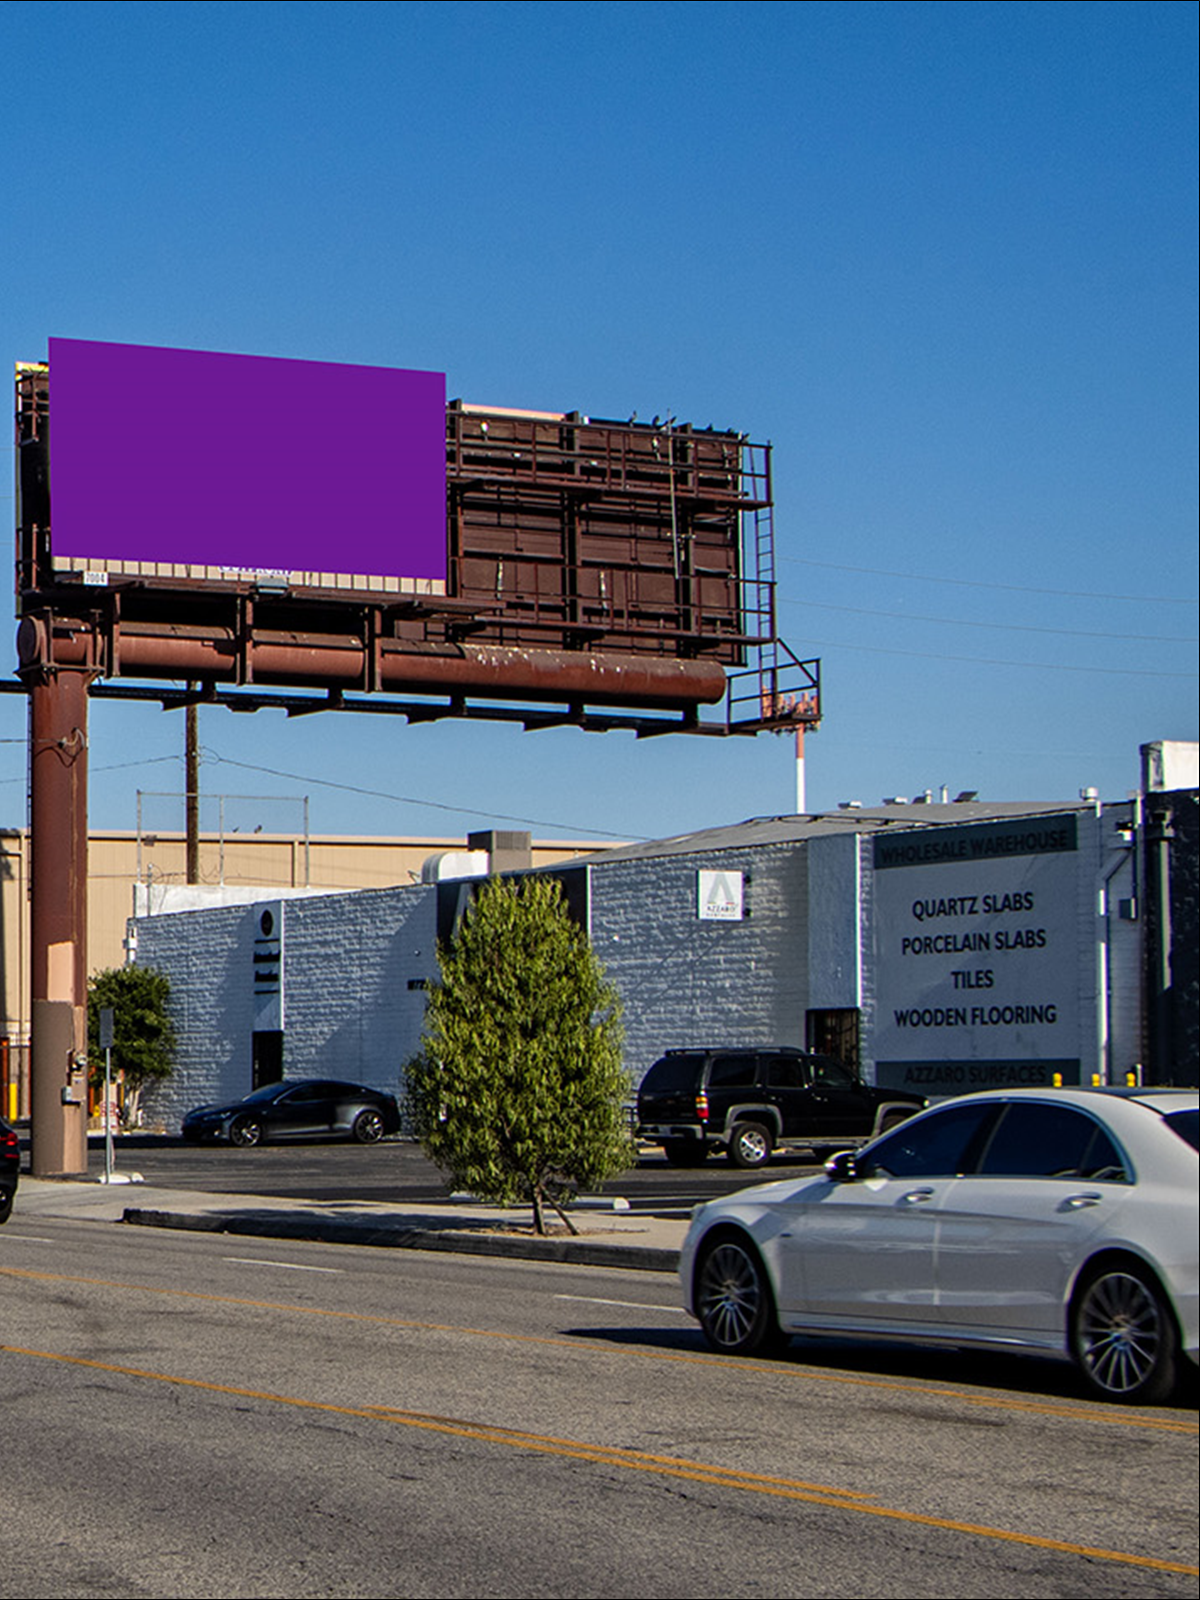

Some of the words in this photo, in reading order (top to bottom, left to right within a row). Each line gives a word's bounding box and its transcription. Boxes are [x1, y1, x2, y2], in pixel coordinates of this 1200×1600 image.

[880, 840, 966, 863] WHOLESALE
[970, 829, 1067, 854] WAREHOUSE
[912, 896, 979, 922] QUARTZ
[982, 891, 1034, 914] SLABS
[902, 931, 990, 955] PORCELAIN
[994, 929, 1047, 951] SLABS
[951, 969, 995, 989] TILES
[894, 1008, 968, 1027] WOODEN
[970, 1004, 1058, 1026] FLOORING
[904, 1067, 966, 1084] AZZARO
[968, 1066, 1047, 1083] SURFACES
